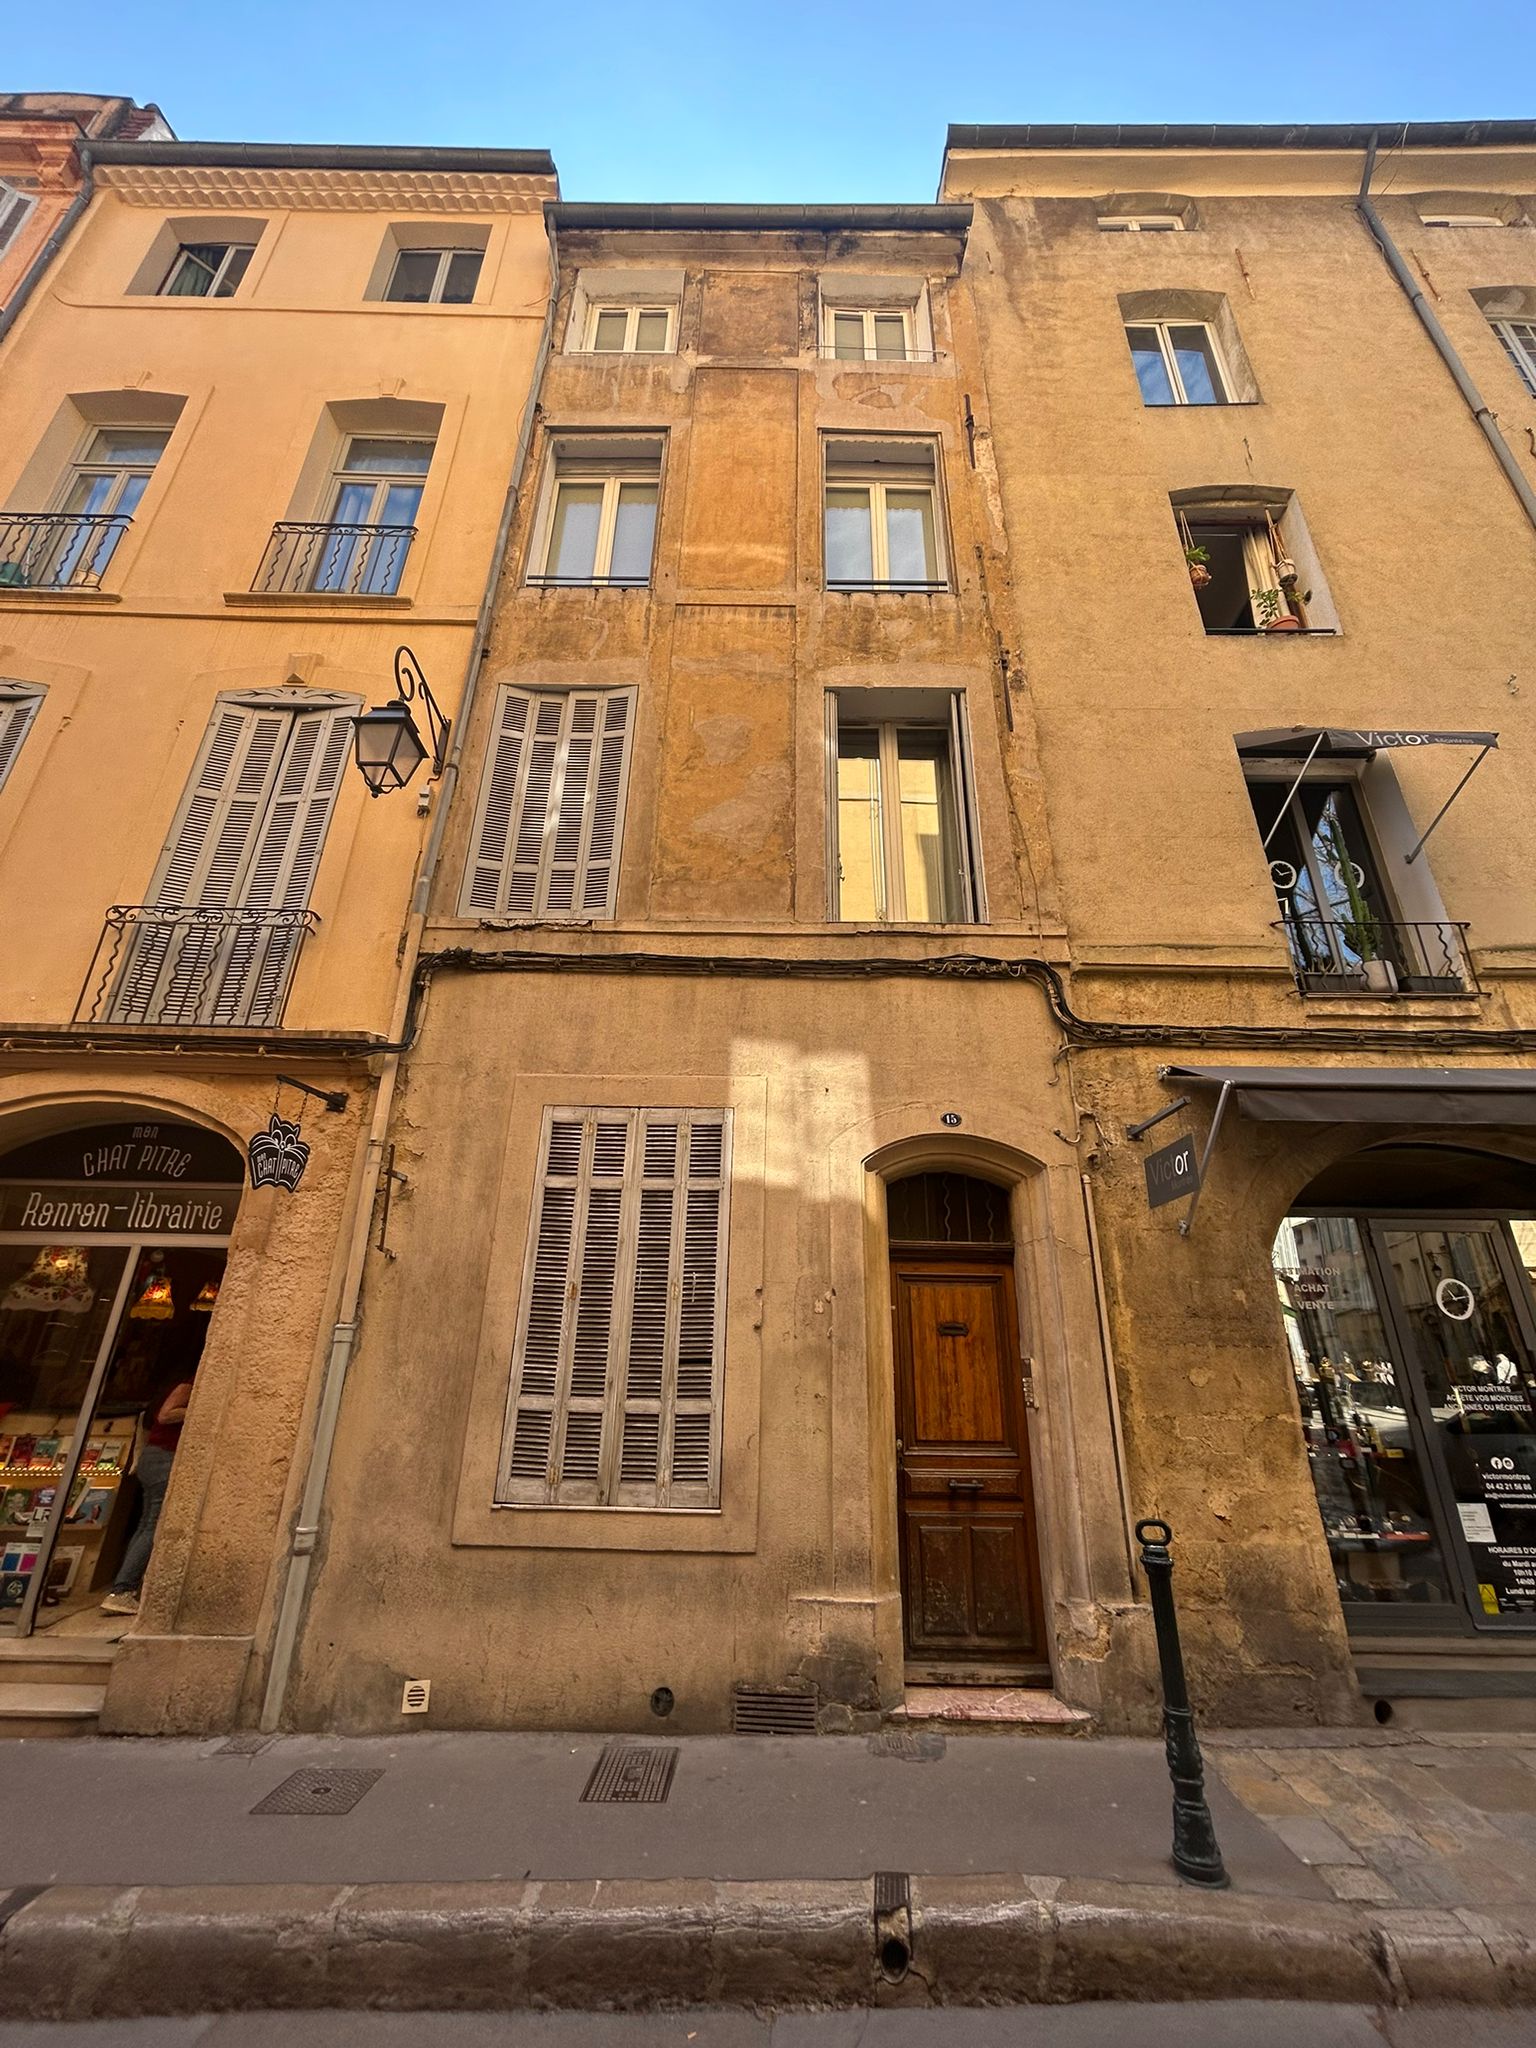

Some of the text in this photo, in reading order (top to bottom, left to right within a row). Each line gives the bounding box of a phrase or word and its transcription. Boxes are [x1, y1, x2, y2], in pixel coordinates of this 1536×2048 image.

[1355, 731, 1429, 746] Victor
[946, 1114, 957, 1124] 15
[132, 1126, 158, 1138] mon
[83, 1144, 192, 1177] CHAT PITRE
[258, 1157, 300, 1178] CHAT PITRE
[1149, 1151, 1188, 1185] Victor
[1294, 1284, 1329, 1292] ACHAT
[1297, 1300, 1335, 1310] VENTE
[1450, 1385, 1511, 1393] VCTOR MONTRES
[1475, 1394, 1490, 1402] VOS
[1490, 1394, 1524, 1402] MONTRES
